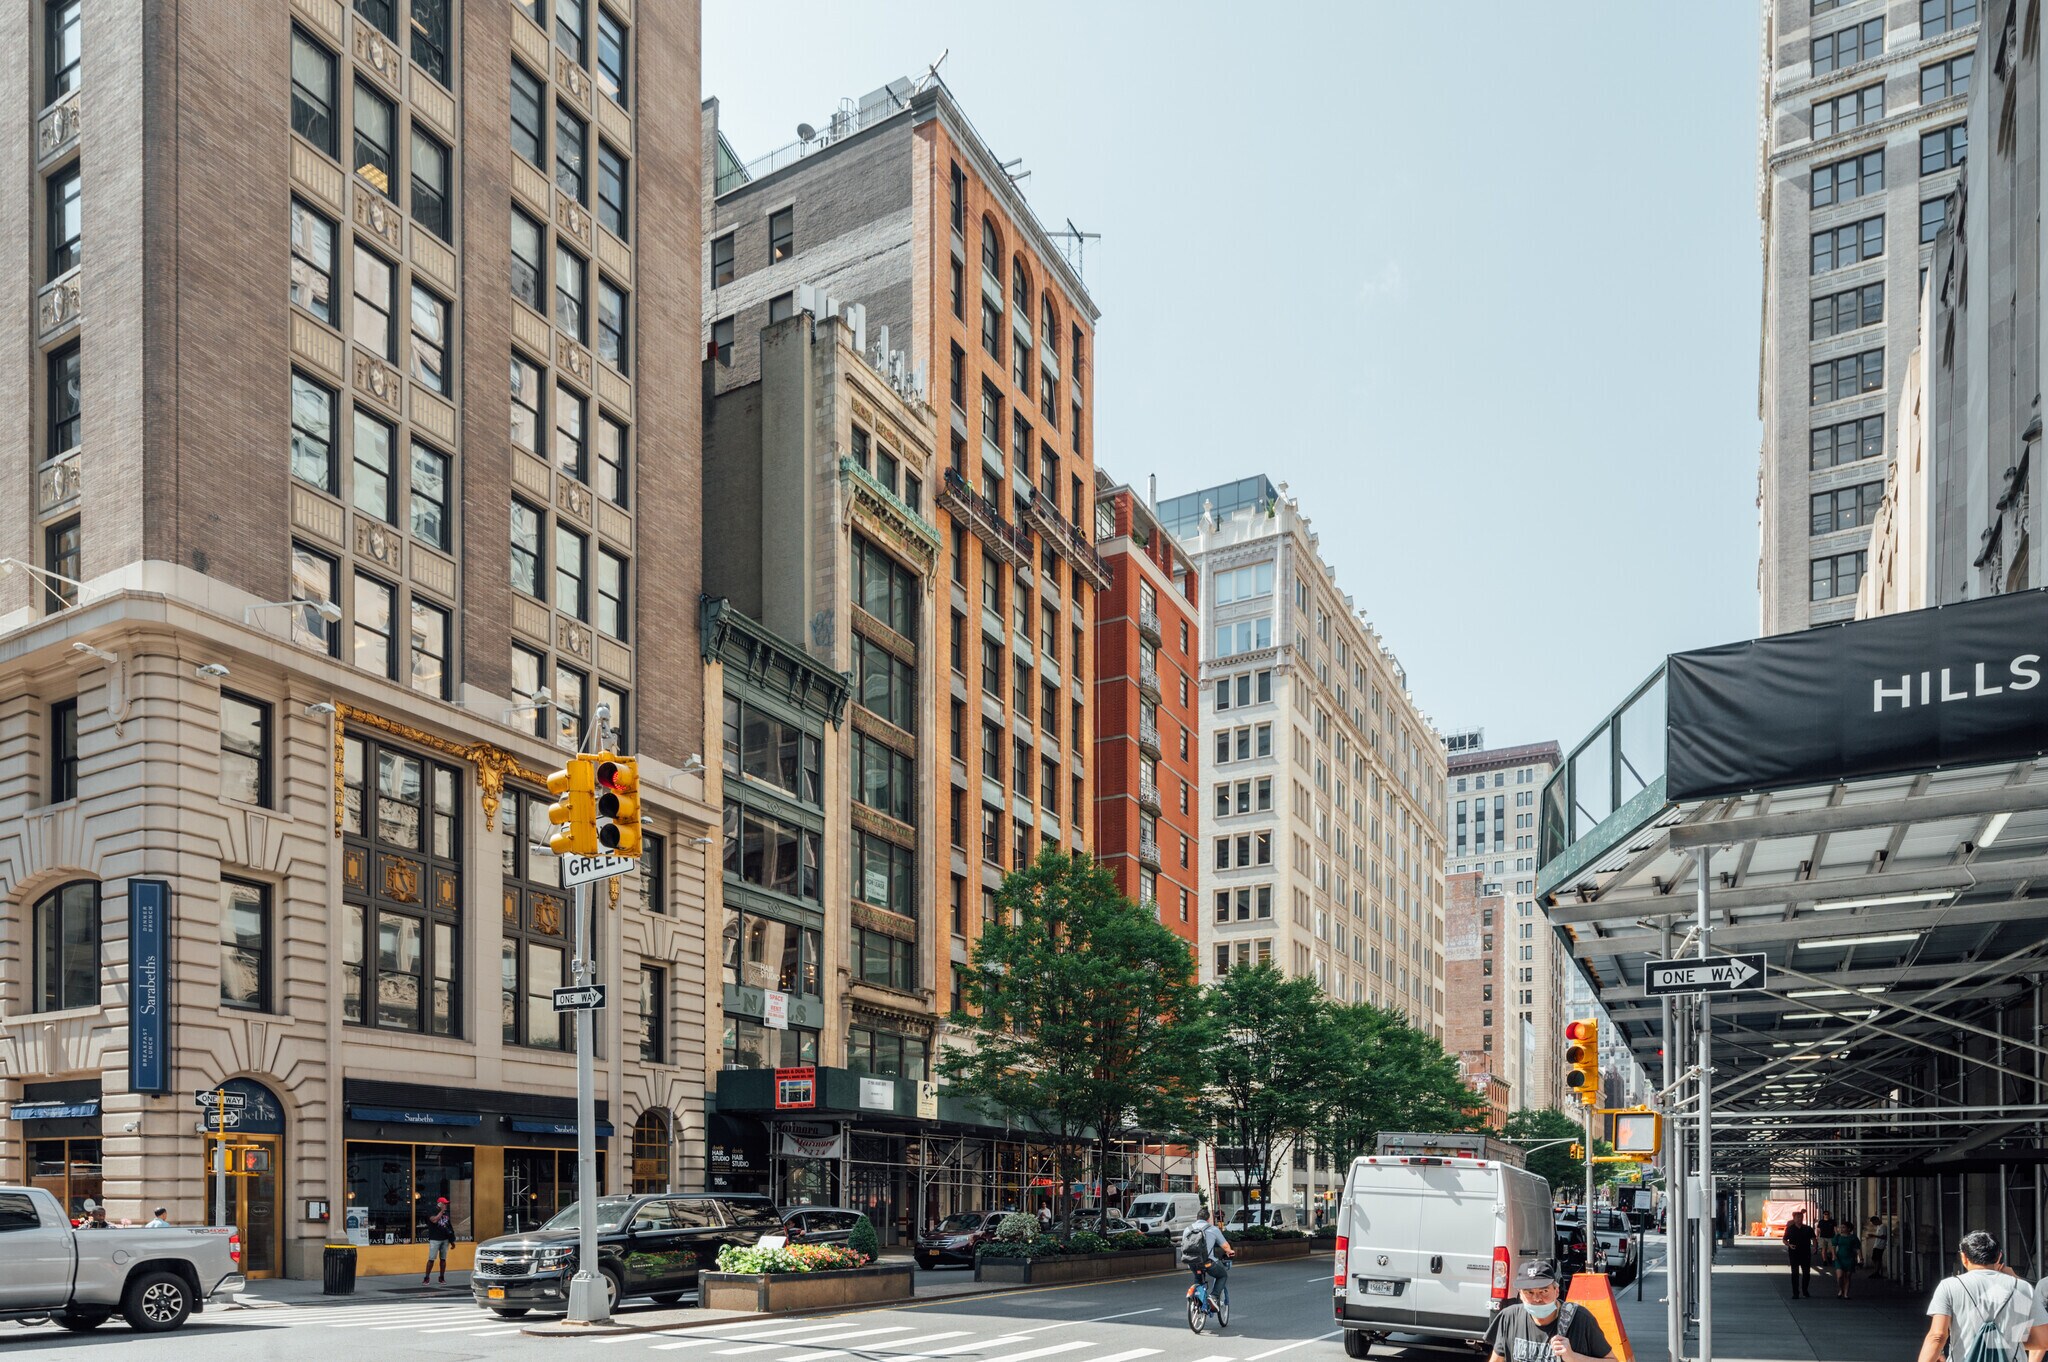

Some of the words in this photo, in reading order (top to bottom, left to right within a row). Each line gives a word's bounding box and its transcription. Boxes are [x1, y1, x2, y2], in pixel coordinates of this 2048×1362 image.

[1873, 654, 2041, 713] HILLS
[1662, 970, 1695, 985] ONE
[1711, 966, 1746, 981] WAY
[139, 955, 156, 1015] Sarabeth's
[559, 994, 574, 1004] ONE
[580, 992, 597, 1002] WAY
[201, 1095, 218, 1103] ONE
[731, 1160, 749, 1168] STUDIO
